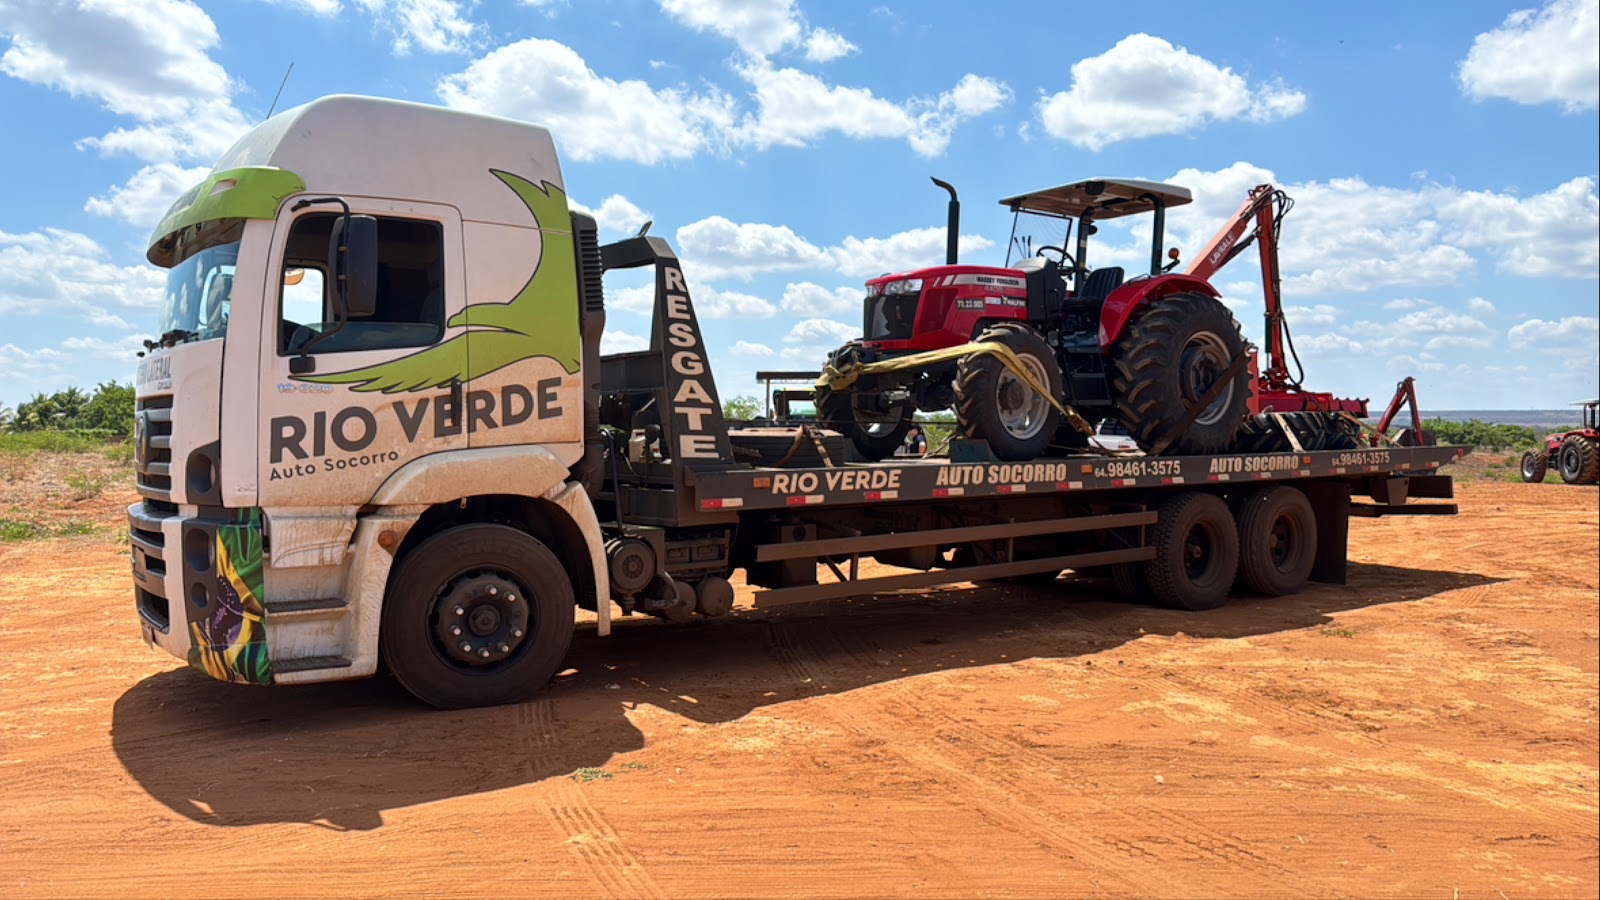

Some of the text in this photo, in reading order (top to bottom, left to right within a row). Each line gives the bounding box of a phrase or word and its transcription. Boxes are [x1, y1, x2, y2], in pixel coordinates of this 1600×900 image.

[664, 266, 720, 459] RESGATE
[270, 377, 563, 464] RIO VERDE
[269, 450, 399, 481] Auto Socorro
[936, 463, 1067, 486] AUTO SOCORRO
[1209, 455, 1299, 474] AUTO SOCORRO
[772, 469, 903, 494] RIO VERDE
